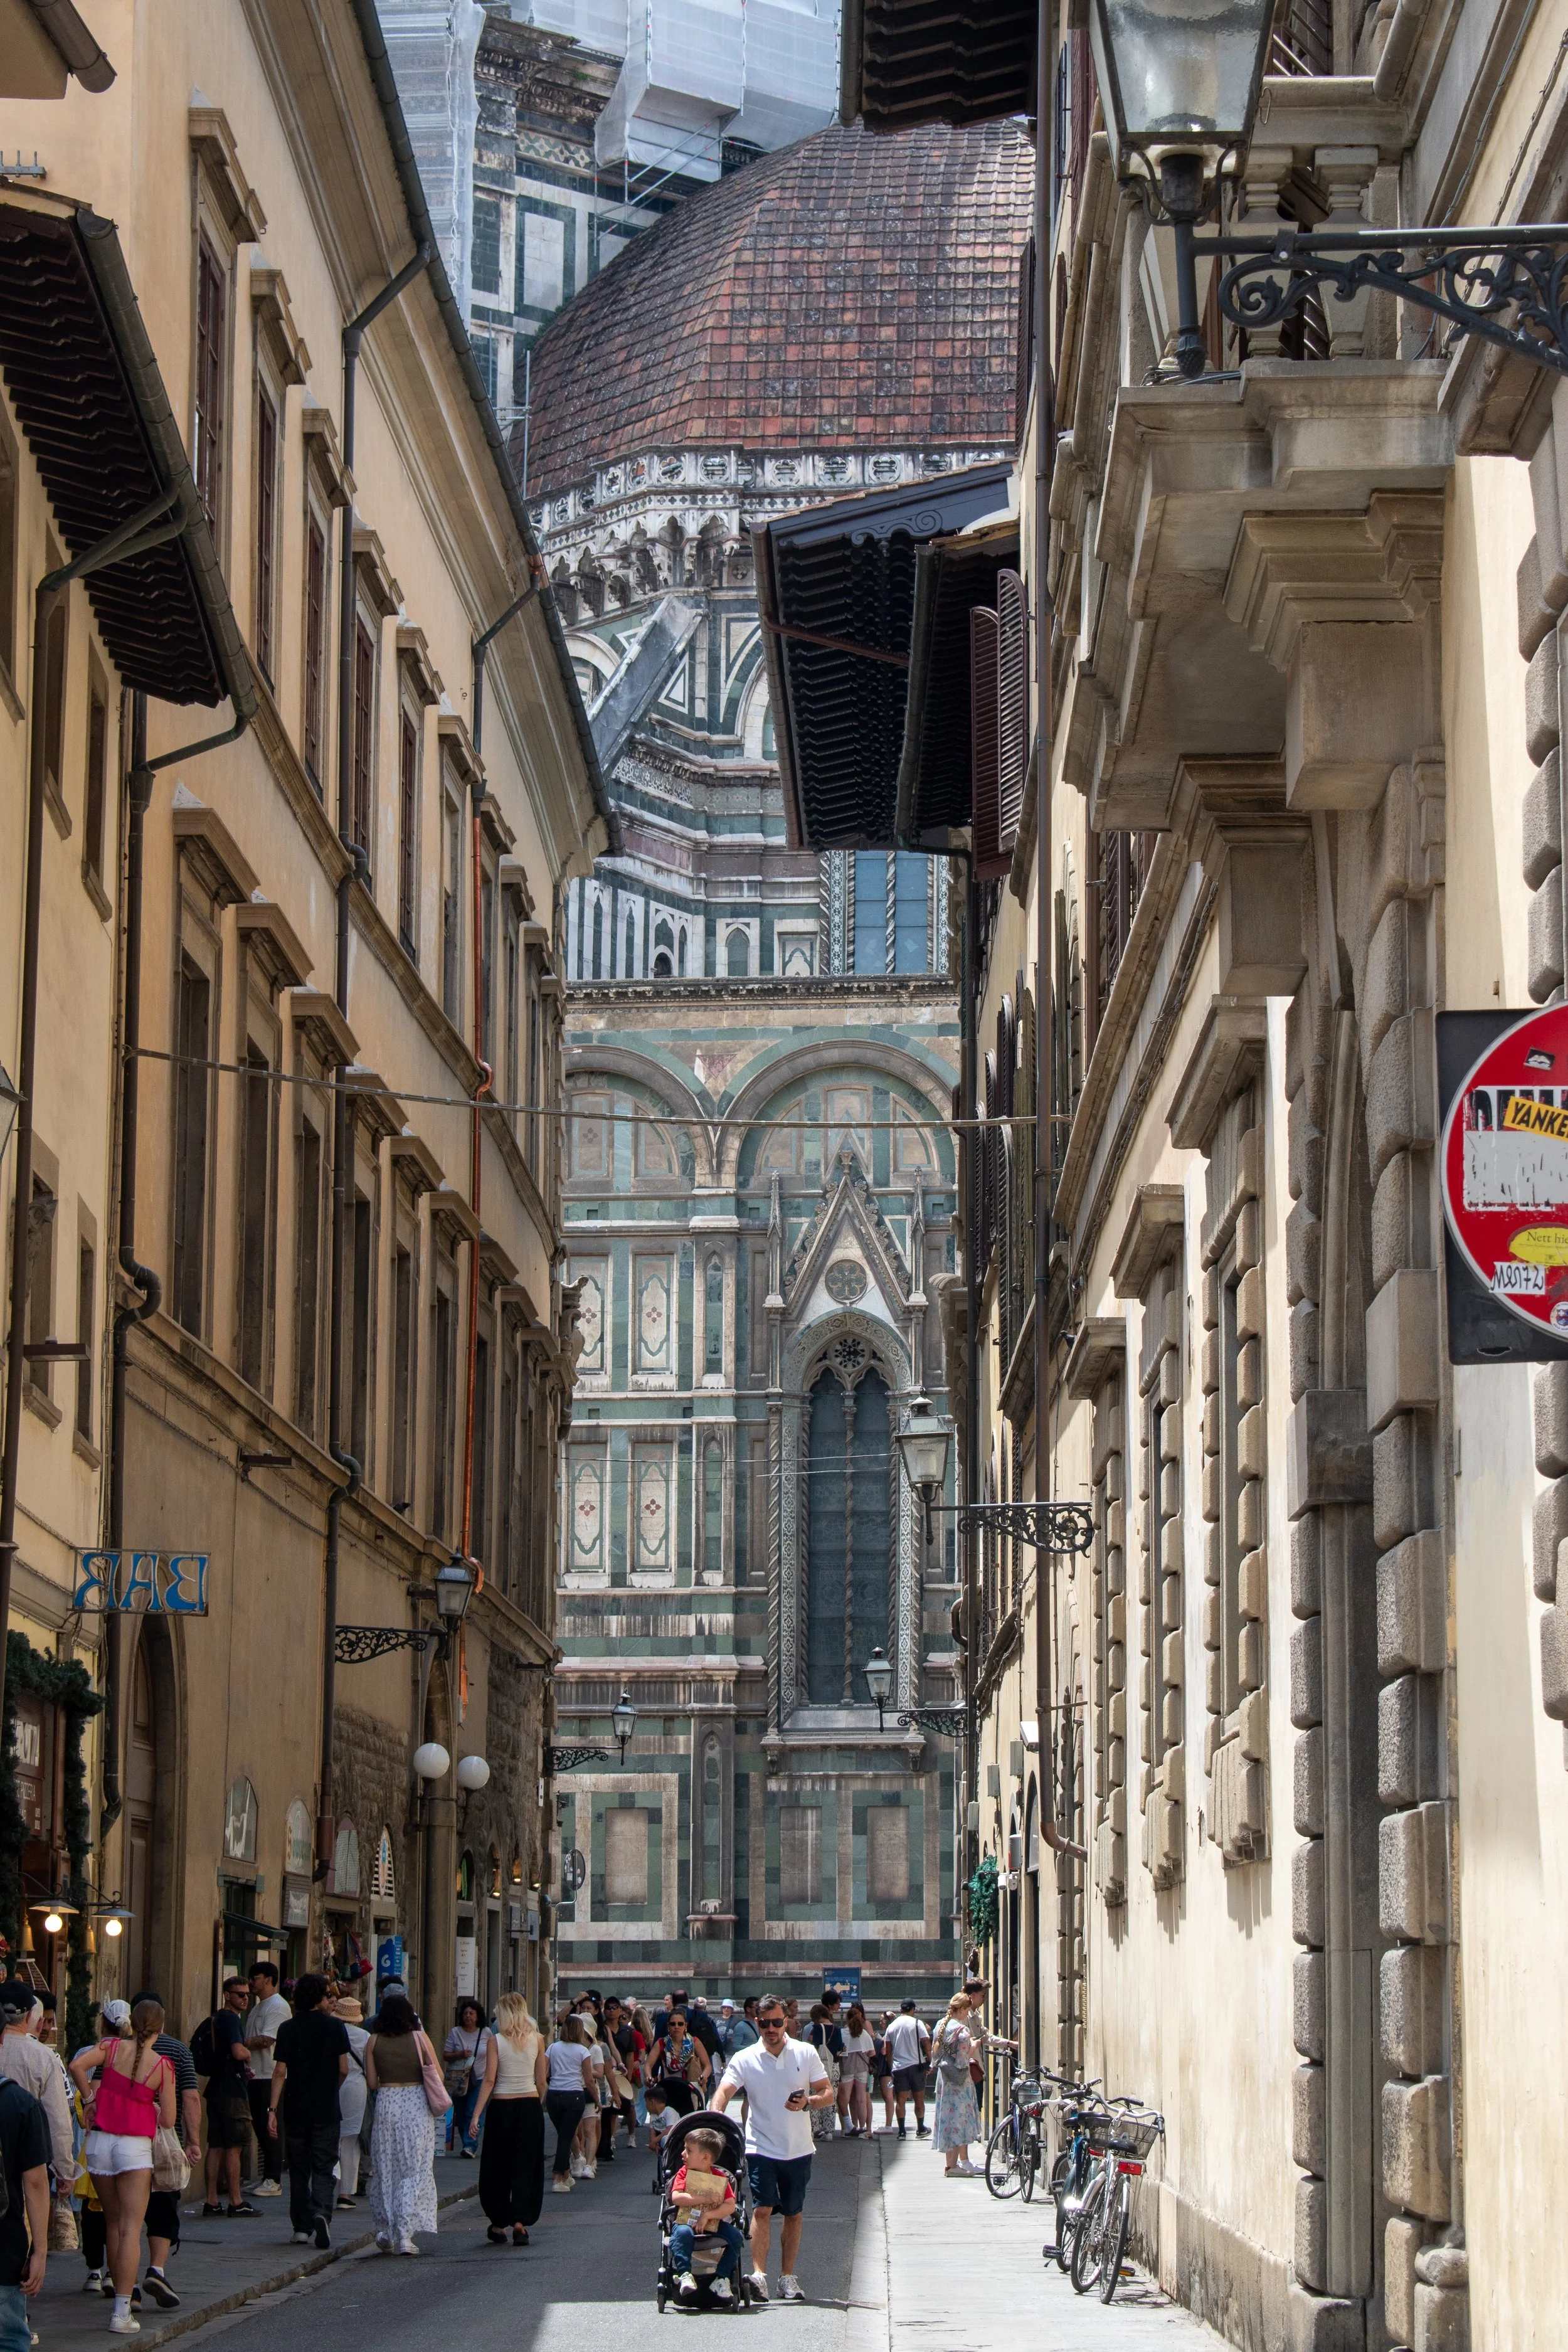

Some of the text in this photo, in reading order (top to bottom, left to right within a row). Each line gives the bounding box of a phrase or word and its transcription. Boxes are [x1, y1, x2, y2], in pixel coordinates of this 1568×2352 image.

[1511, 1101, 1568, 1138] YANKE
[1527, 1231, 1552, 1242] Nett
[21, 1781, 36, 1802] PIZZERIA
